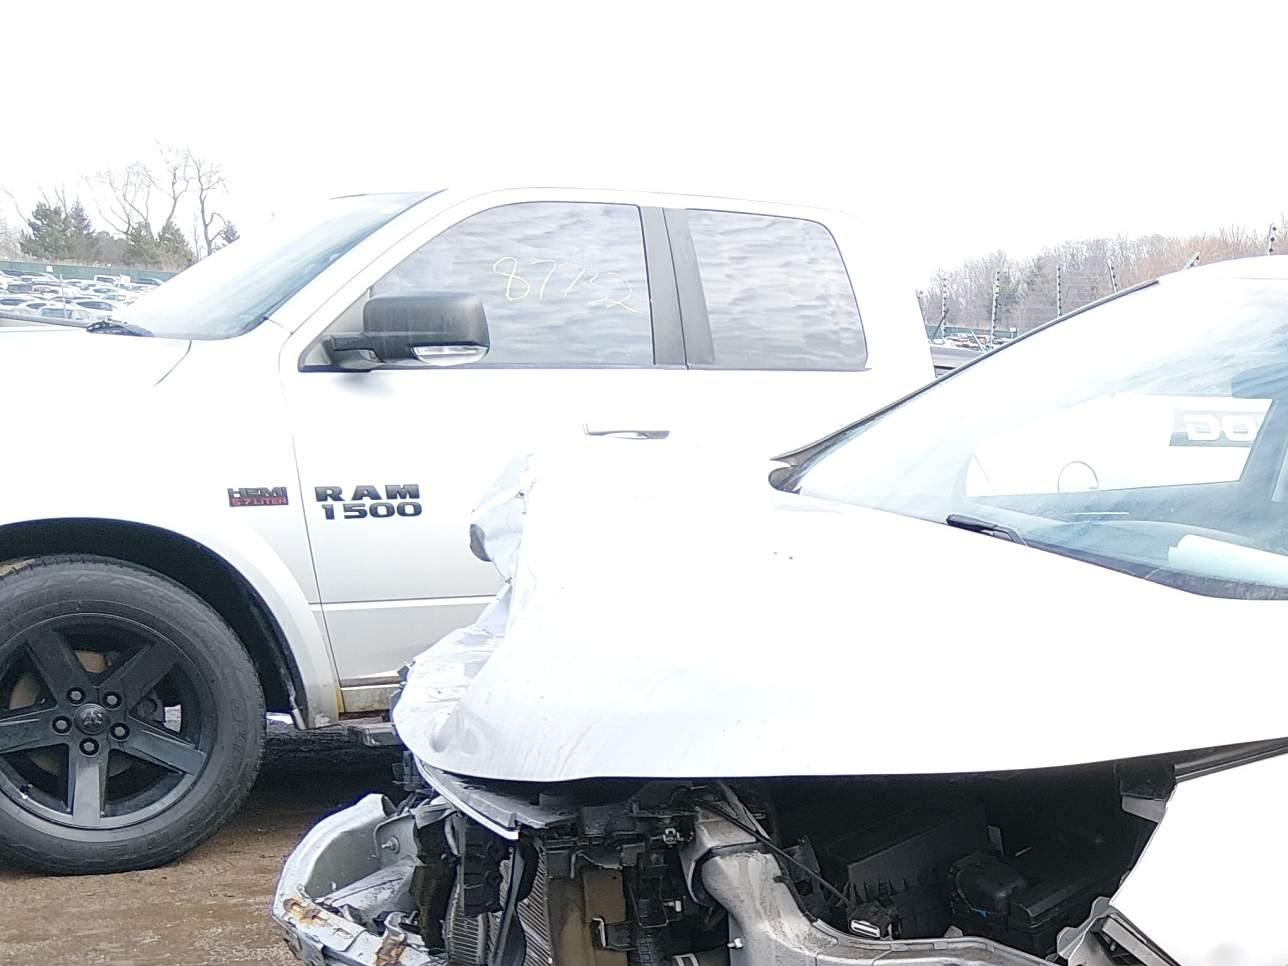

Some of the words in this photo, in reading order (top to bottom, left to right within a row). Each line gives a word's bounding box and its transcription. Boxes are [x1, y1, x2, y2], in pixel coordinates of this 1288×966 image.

[1184, 414, 1264, 441] DO
[227, 487, 287, 498] HEMI
[314, 484, 420, 502] RAM
[321, 502, 423, 520] 1500
